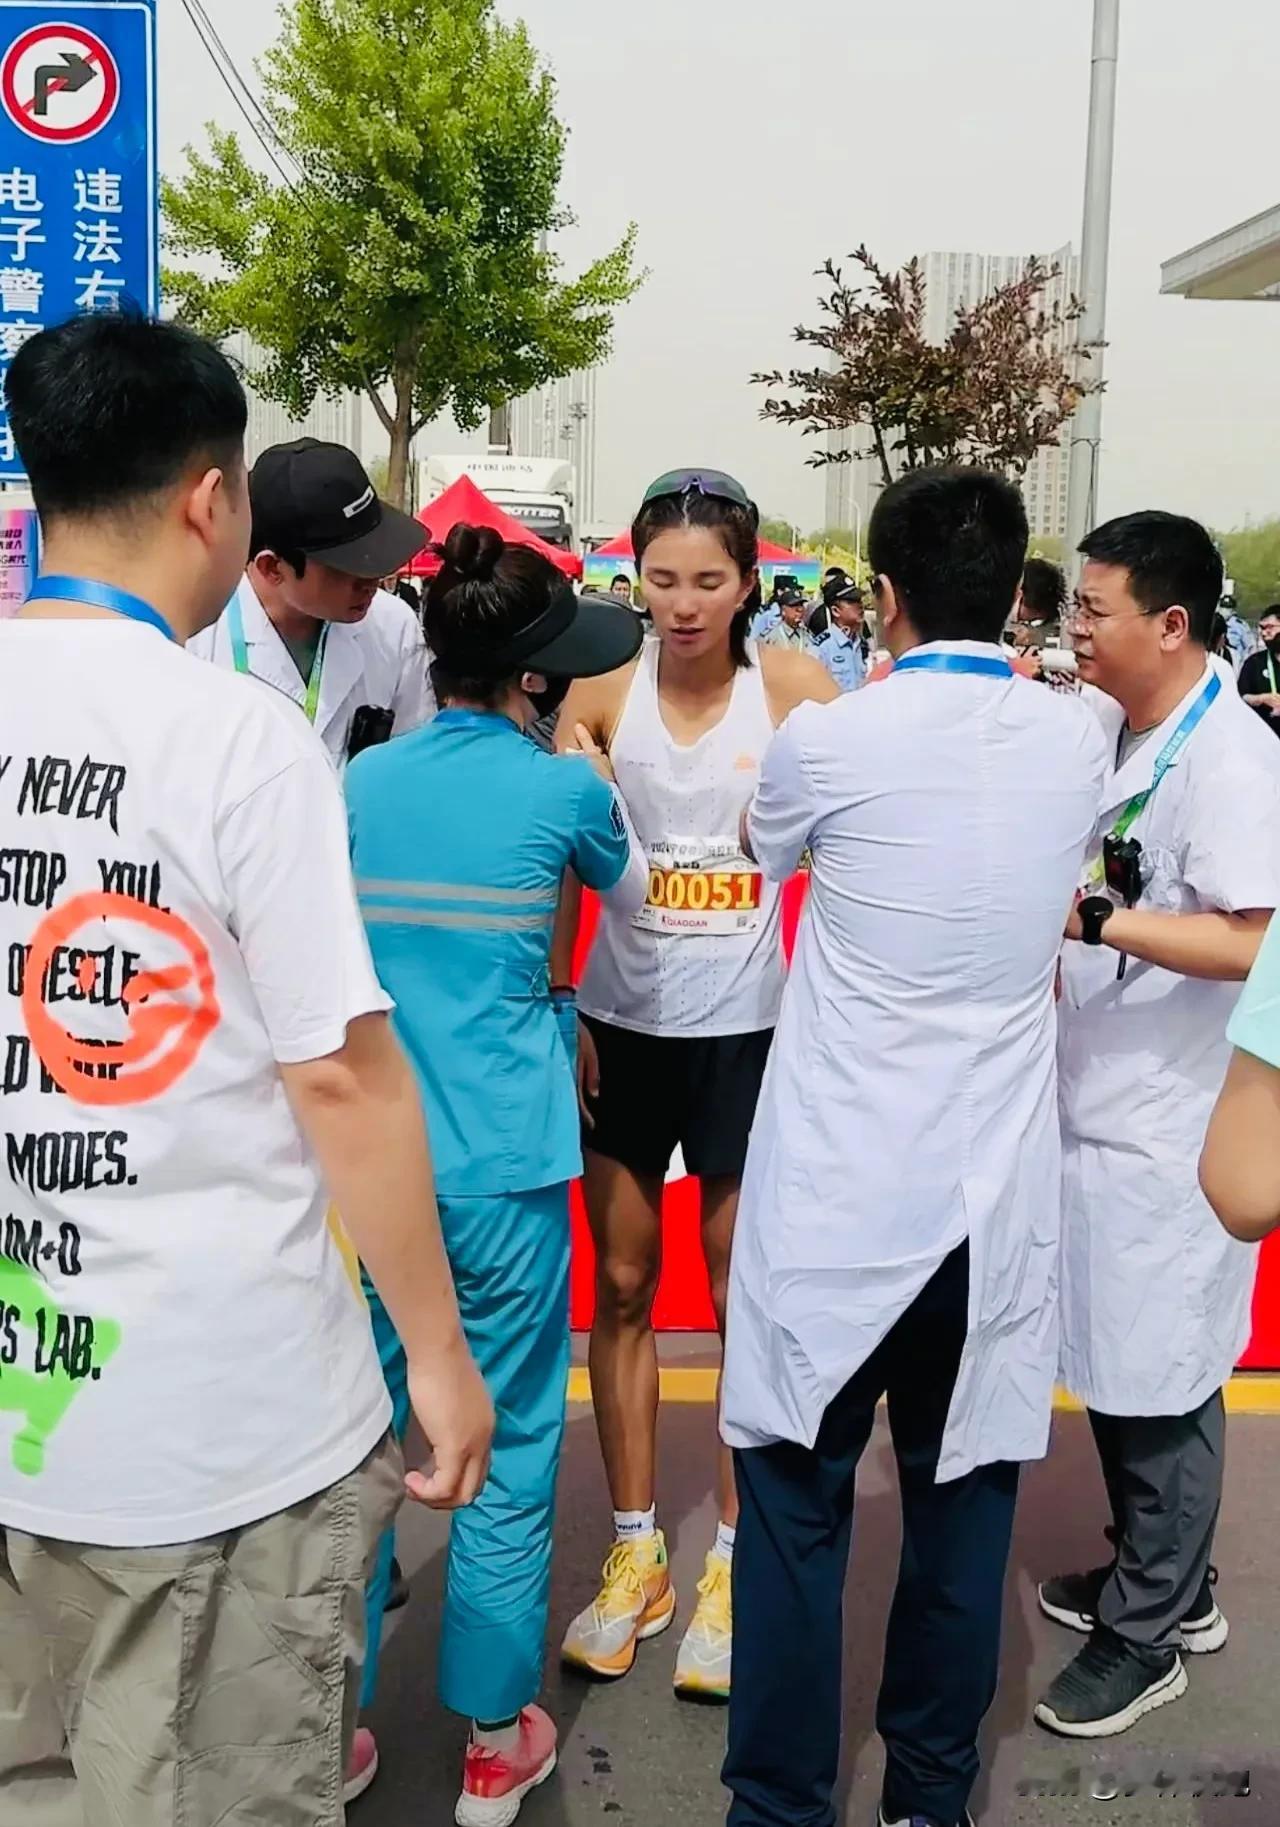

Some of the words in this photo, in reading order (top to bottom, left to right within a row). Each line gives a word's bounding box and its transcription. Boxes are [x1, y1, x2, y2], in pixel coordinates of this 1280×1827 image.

[17, 753, 126, 836] NEVER
[0, 849, 66, 910] STOP
[648, 869, 754, 910] 00051
[6, 1130, 138, 1197] MODES.
[35, 1307, 101, 1380] LAB.
